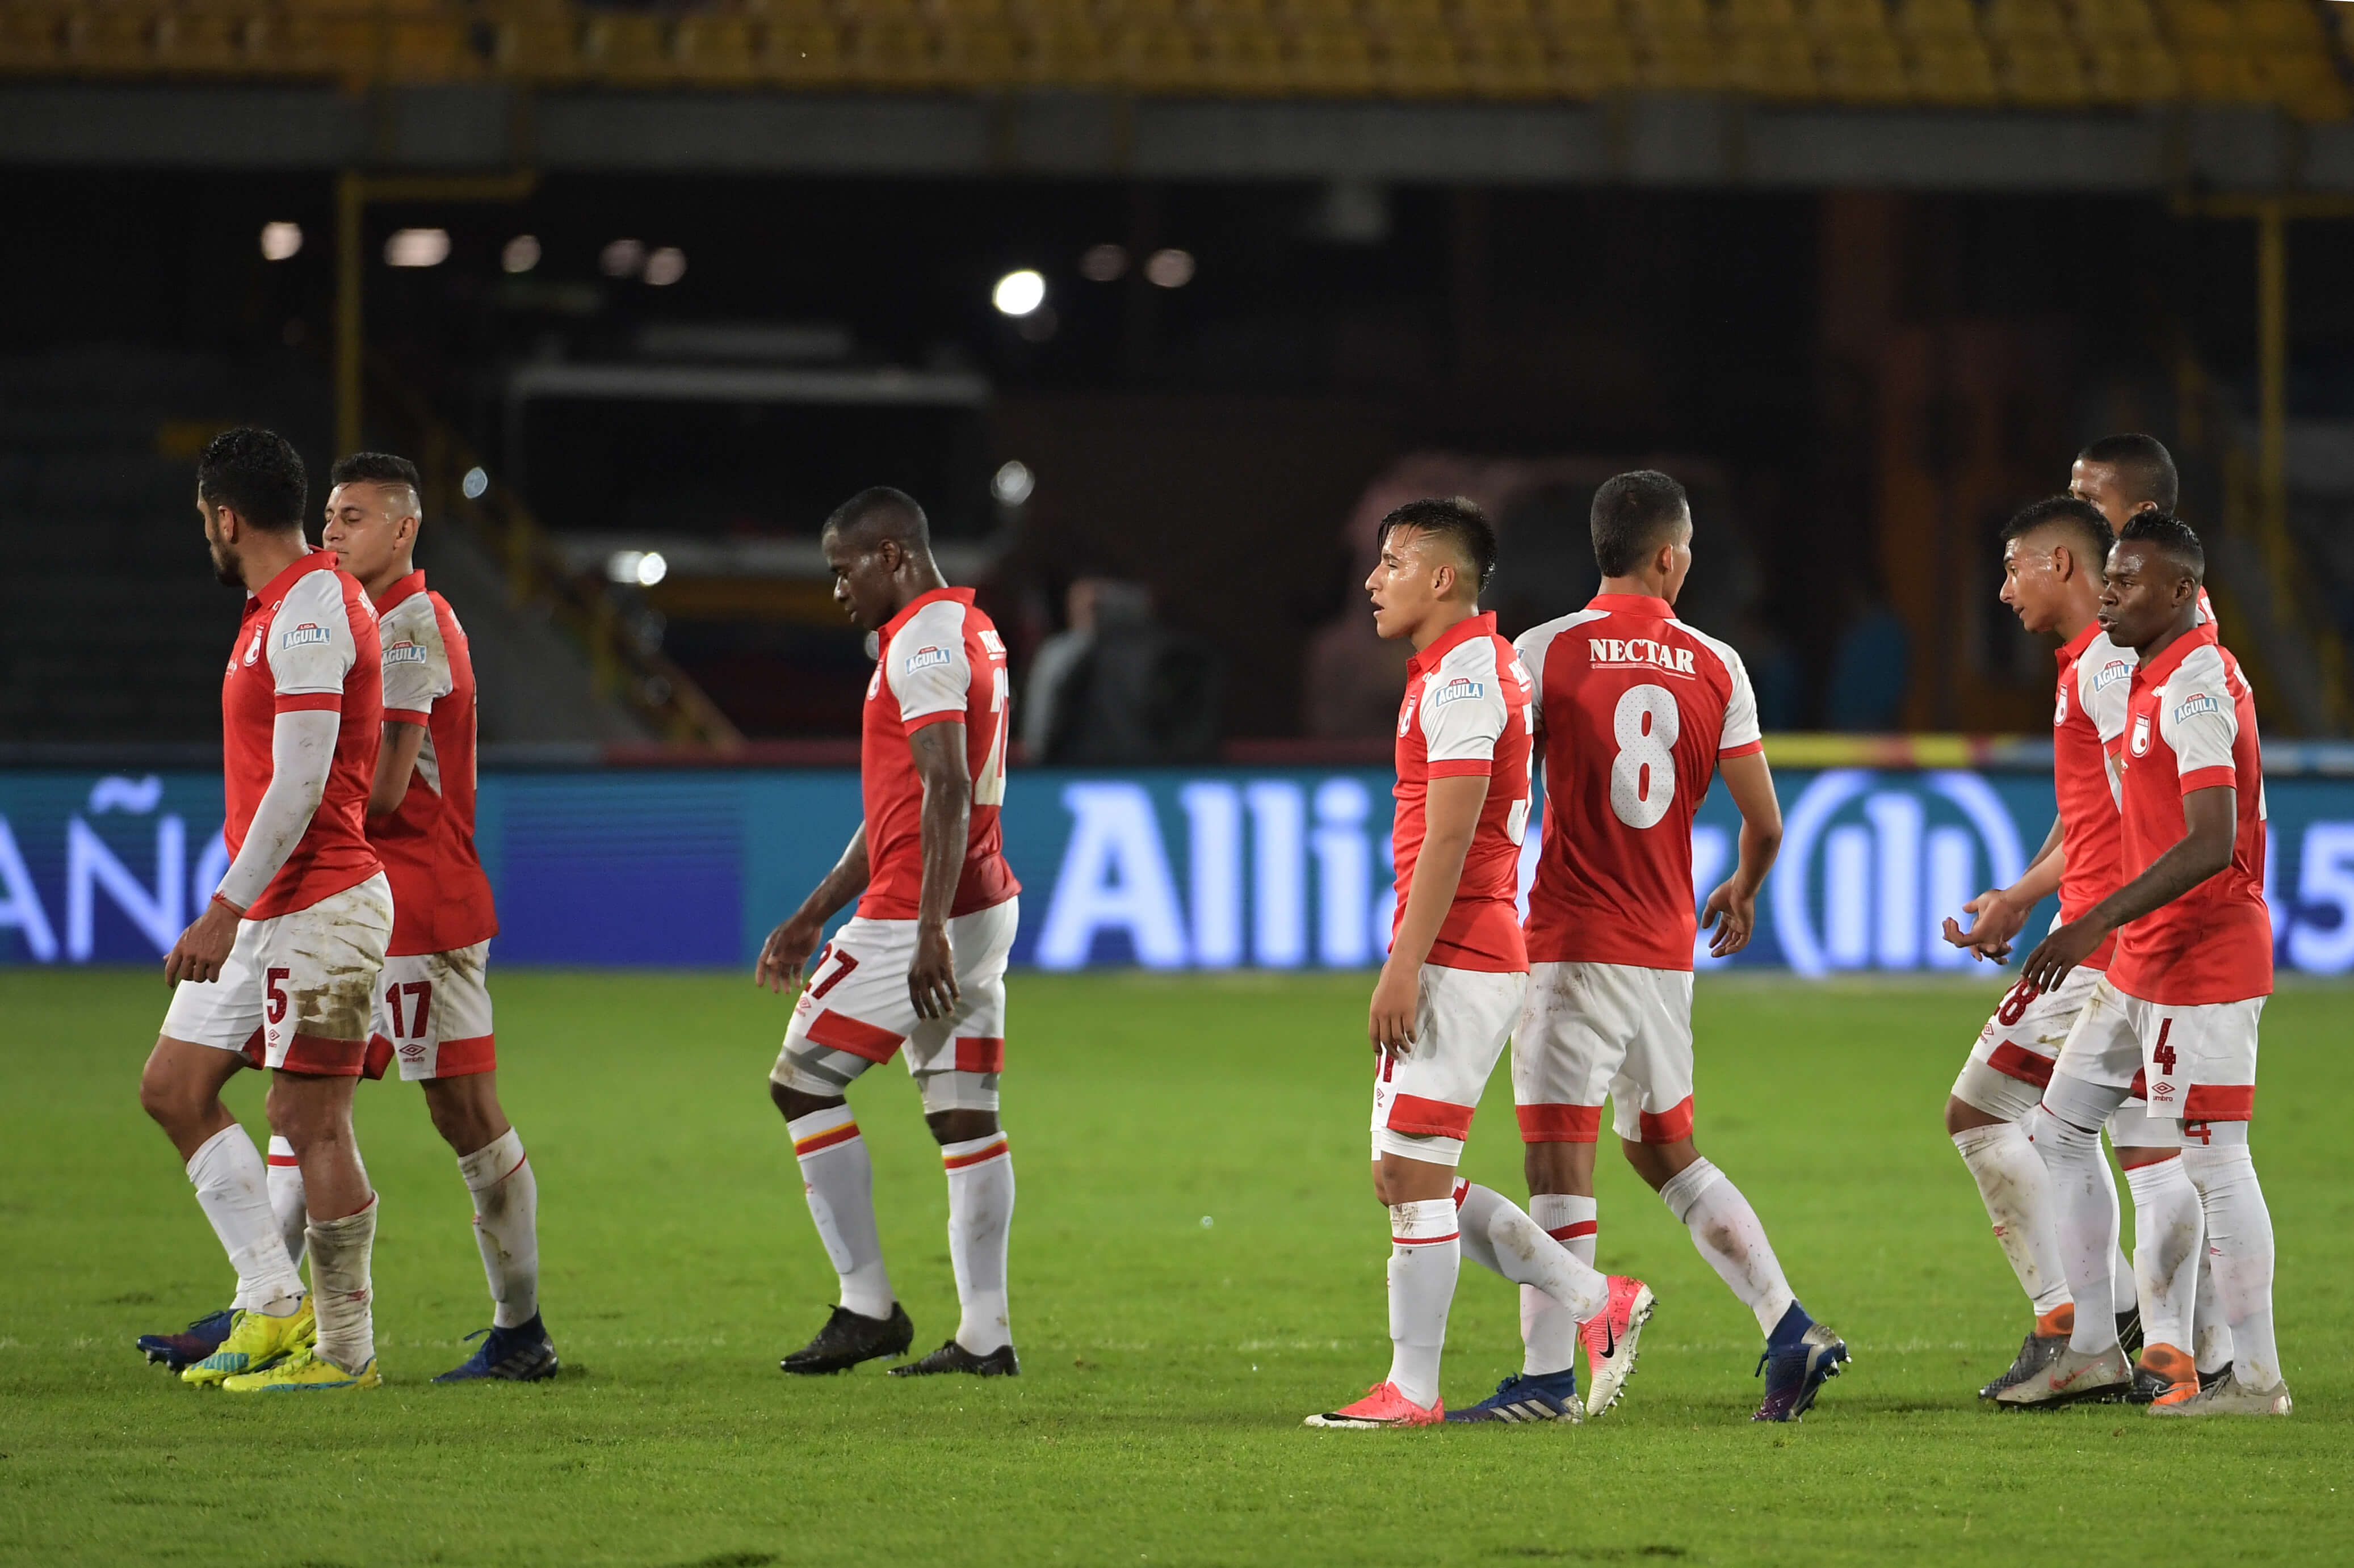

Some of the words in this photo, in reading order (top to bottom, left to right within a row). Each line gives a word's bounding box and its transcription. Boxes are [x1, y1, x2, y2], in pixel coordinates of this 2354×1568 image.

[286, 628, 329, 648] AGUILA
[381, 647, 423, 666] AGUILA
[909, 650, 949, 672] AGUILA
[1588, 638, 1696, 674] NECTAR
[1438, 683, 1482, 706] AGUILA
[2178, 698, 2217, 723] AGUILA
[1610, 684, 1679, 830] 8
[267, 967, 290, 1024] 5
[385, 980, 432, 1039] 17
[2152, 1018, 2176, 1075] 4
